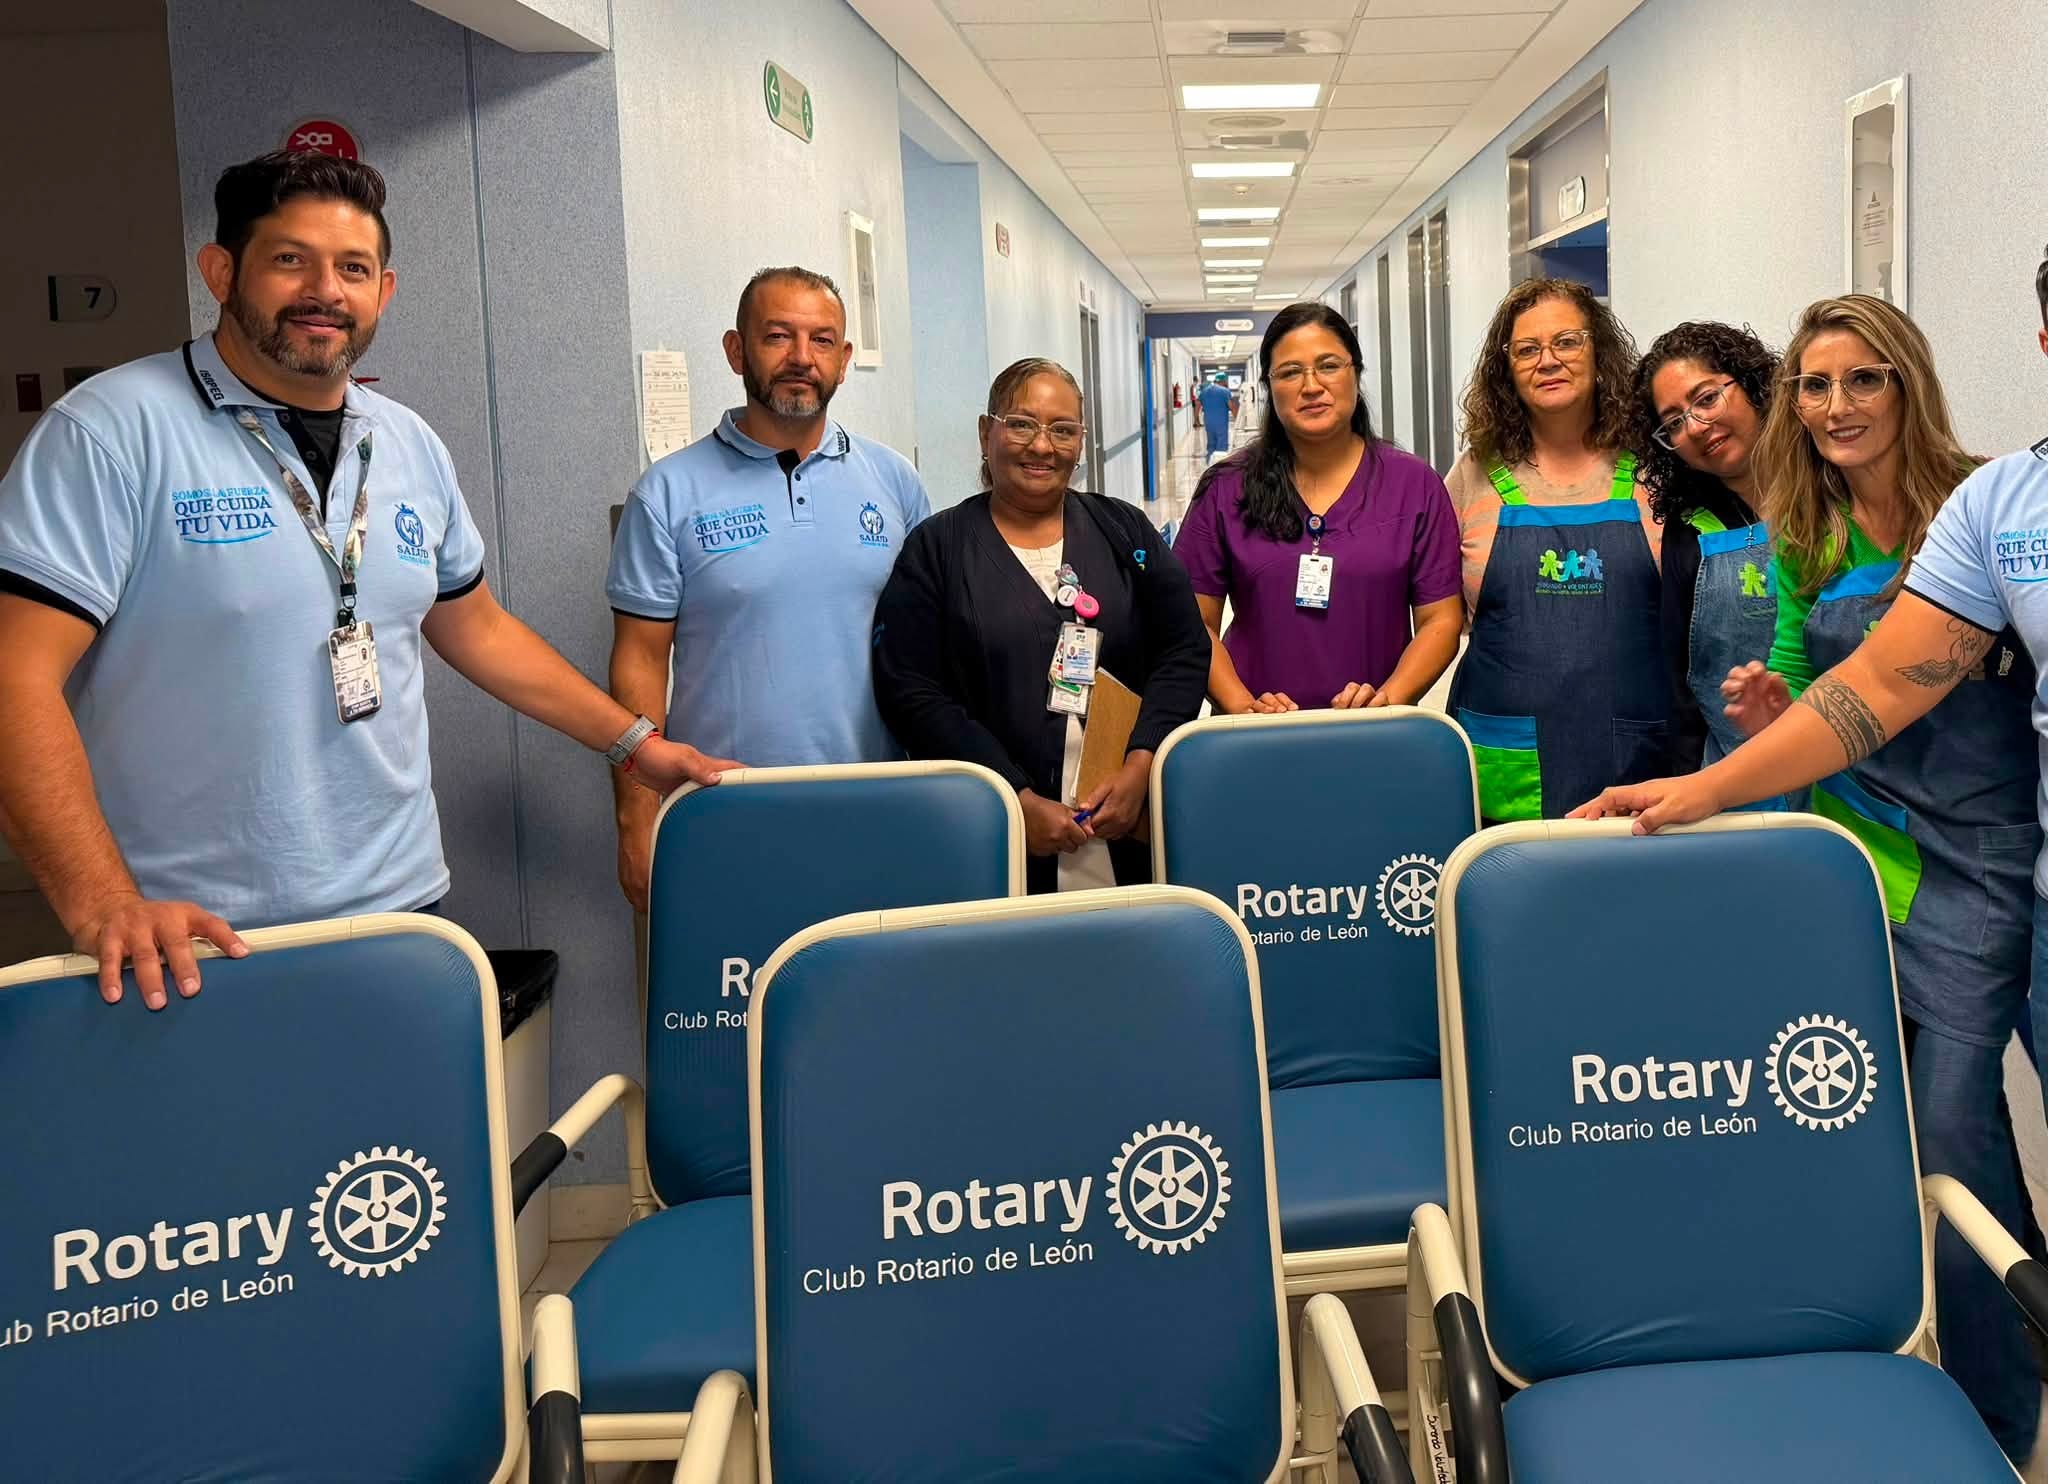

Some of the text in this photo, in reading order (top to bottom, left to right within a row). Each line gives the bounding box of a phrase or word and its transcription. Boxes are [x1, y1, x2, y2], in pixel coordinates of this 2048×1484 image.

[84, 287, 101, 309] 7
[174, 496, 273, 517] QUE CUIDA
[175, 512, 280, 536] TU VIDA
[695, 520, 721, 536] QUE
[724, 511, 766, 528] CUIDA
[697, 522, 770, 549] TU VIDA
[859, 534, 889, 543] SALUD
[1996, 540, 2026, 558] QUE
[397, 544, 429, 559] SALUD
[1999, 557, 2024, 575] TU
[1235, 883, 1368, 920] Rotary
[1300, 926, 1321, 942] de
[1328, 923, 1368, 940] León
[721, 957, 757, 997] R
[664, 1011, 708, 1030] Club
[1572, 1054, 1753, 1108] Rotary
[1508, 1111, 1757, 1148] Club Rotario de León
[882, 1177, 1093, 1240] Rotary
[53, 1207, 294, 1291] Rotary
[803, 1238, 1094, 1294] Club Rotario de León
[46, 1294, 159, 1338] Rotario
[171, 1286, 209, 1312] de
[221, 1270, 294, 1303] León
